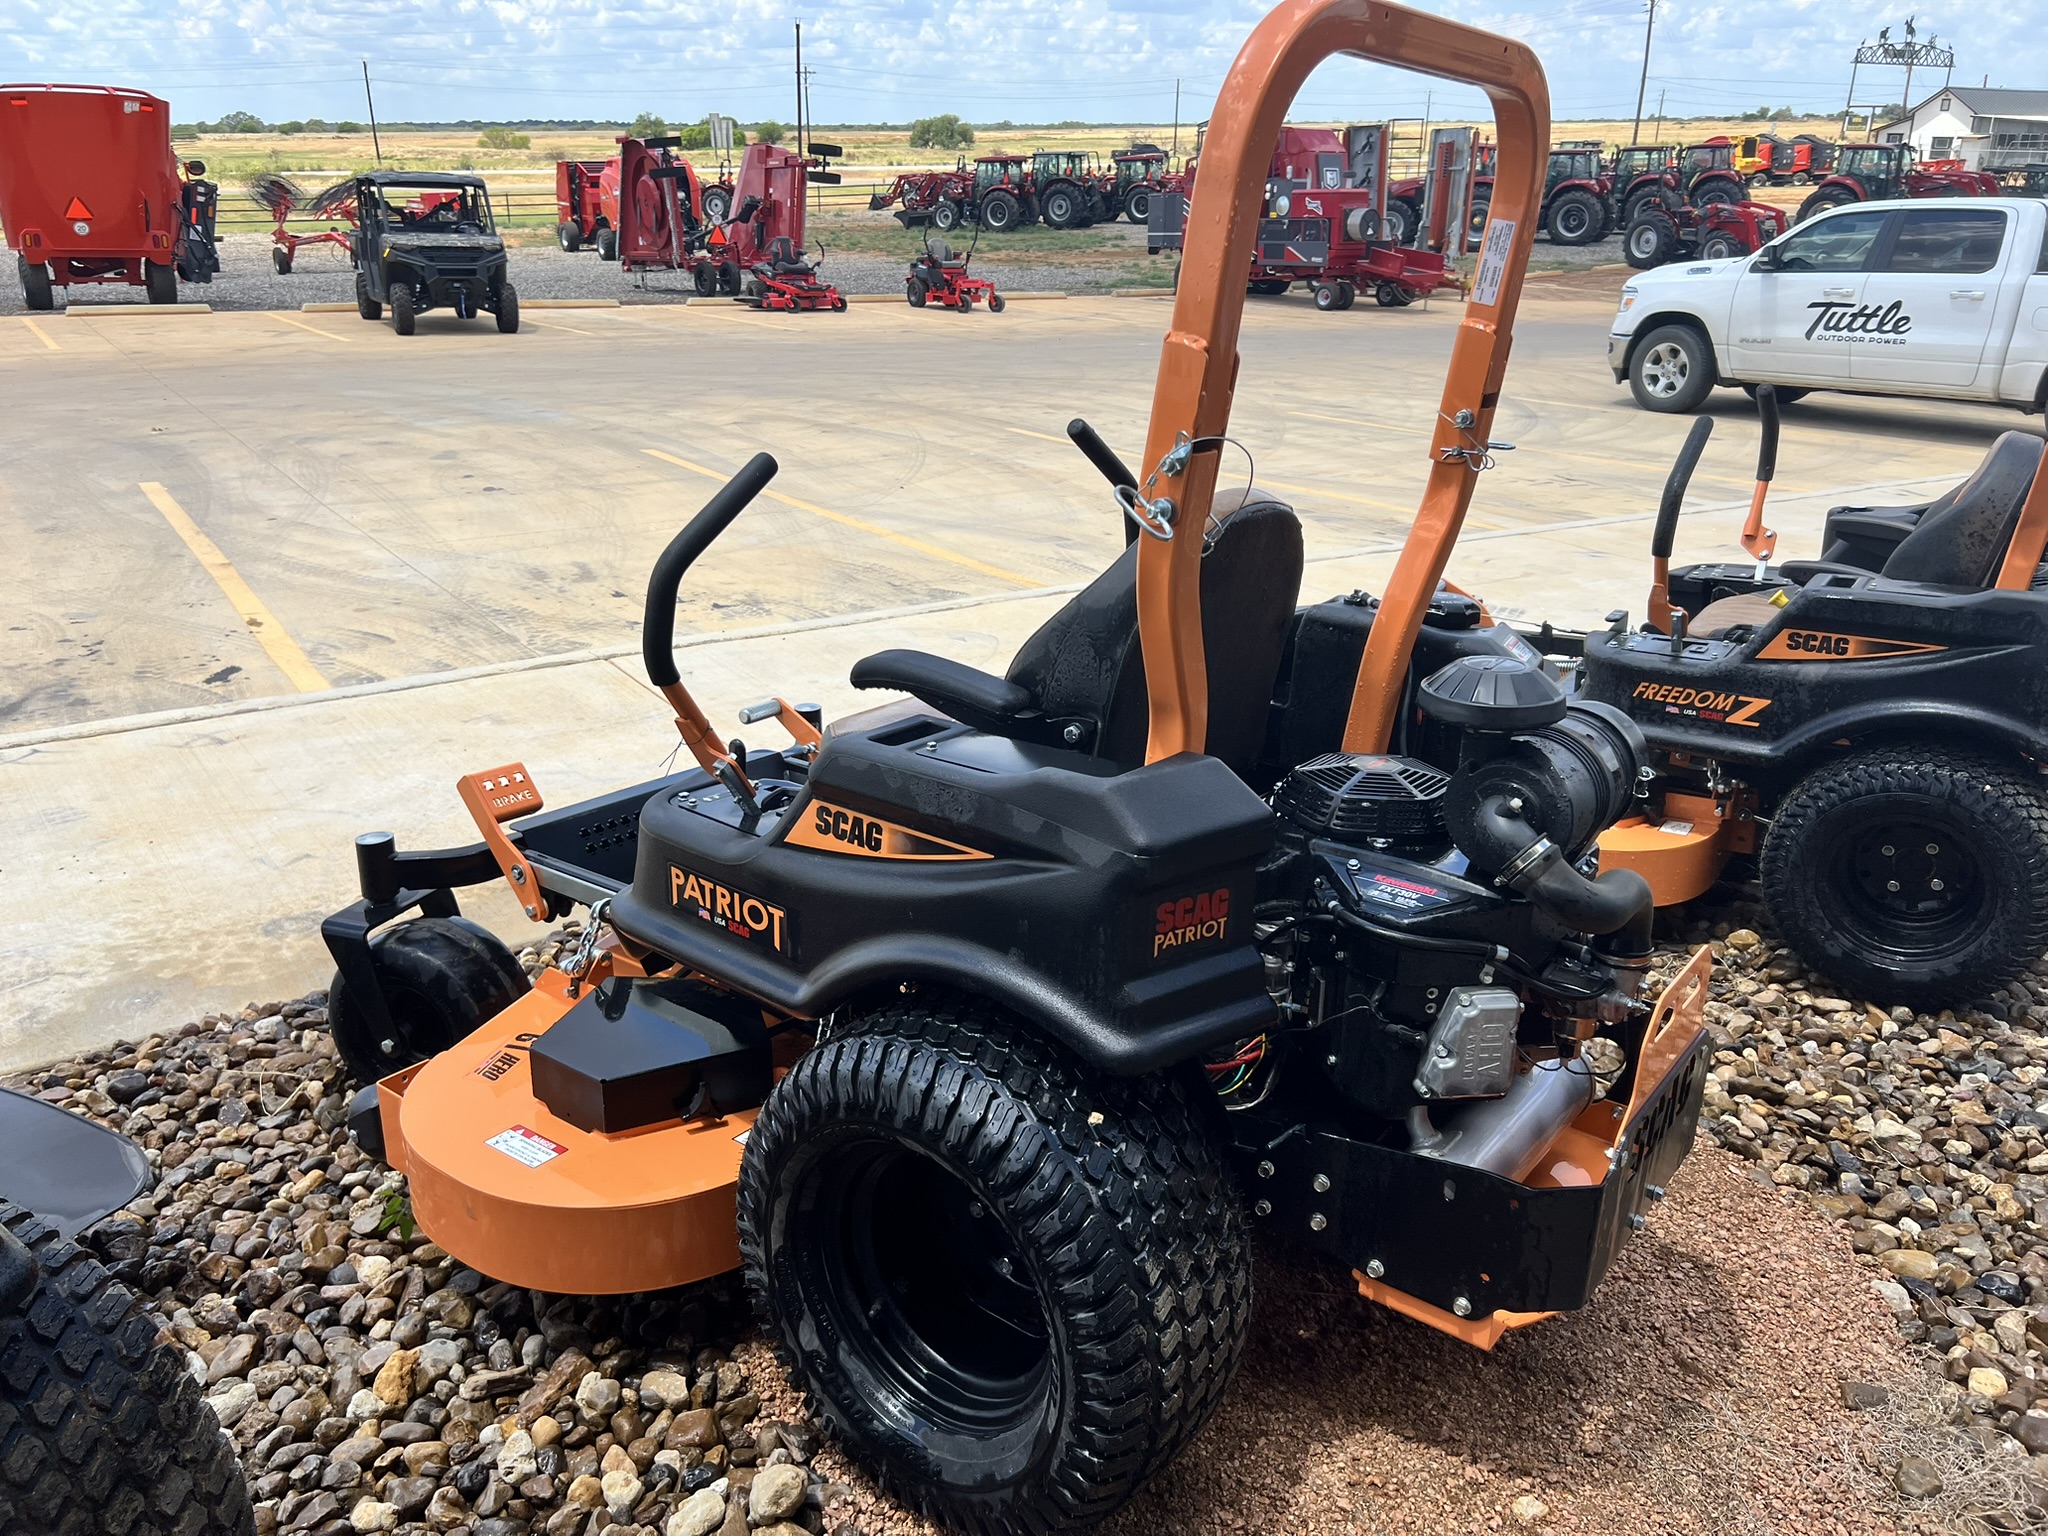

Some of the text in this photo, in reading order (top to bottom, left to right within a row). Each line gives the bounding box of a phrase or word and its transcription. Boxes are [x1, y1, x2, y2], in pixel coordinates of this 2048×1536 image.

[1805, 300, 1912, 341] Tuttle
[1817, 334, 1907, 345] OUTDOOR POWER
[1786, 632, 1850, 656] SCAG
[1632, 681, 1772, 727] FREEDOM Z
[1683, 708, 1724, 721] USA SCAG
[493, 789, 534, 808] BRAKE
[815, 805, 884, 853] SCAG
[1374, 874, 1438, 896] Kawasaki
[1377, 884, 1421, 899] FX730V
[670, 866, 785, 952] PATRIOT
[1155, 888, 1230, 933] SCAG
[713, 916, 751, 939] USA SCAG
[1153, 917, 1228, 958] PATRIOT
[482, 1052, 521, 1081] HERO
[529, 1134, 557, 1150] DANGER
